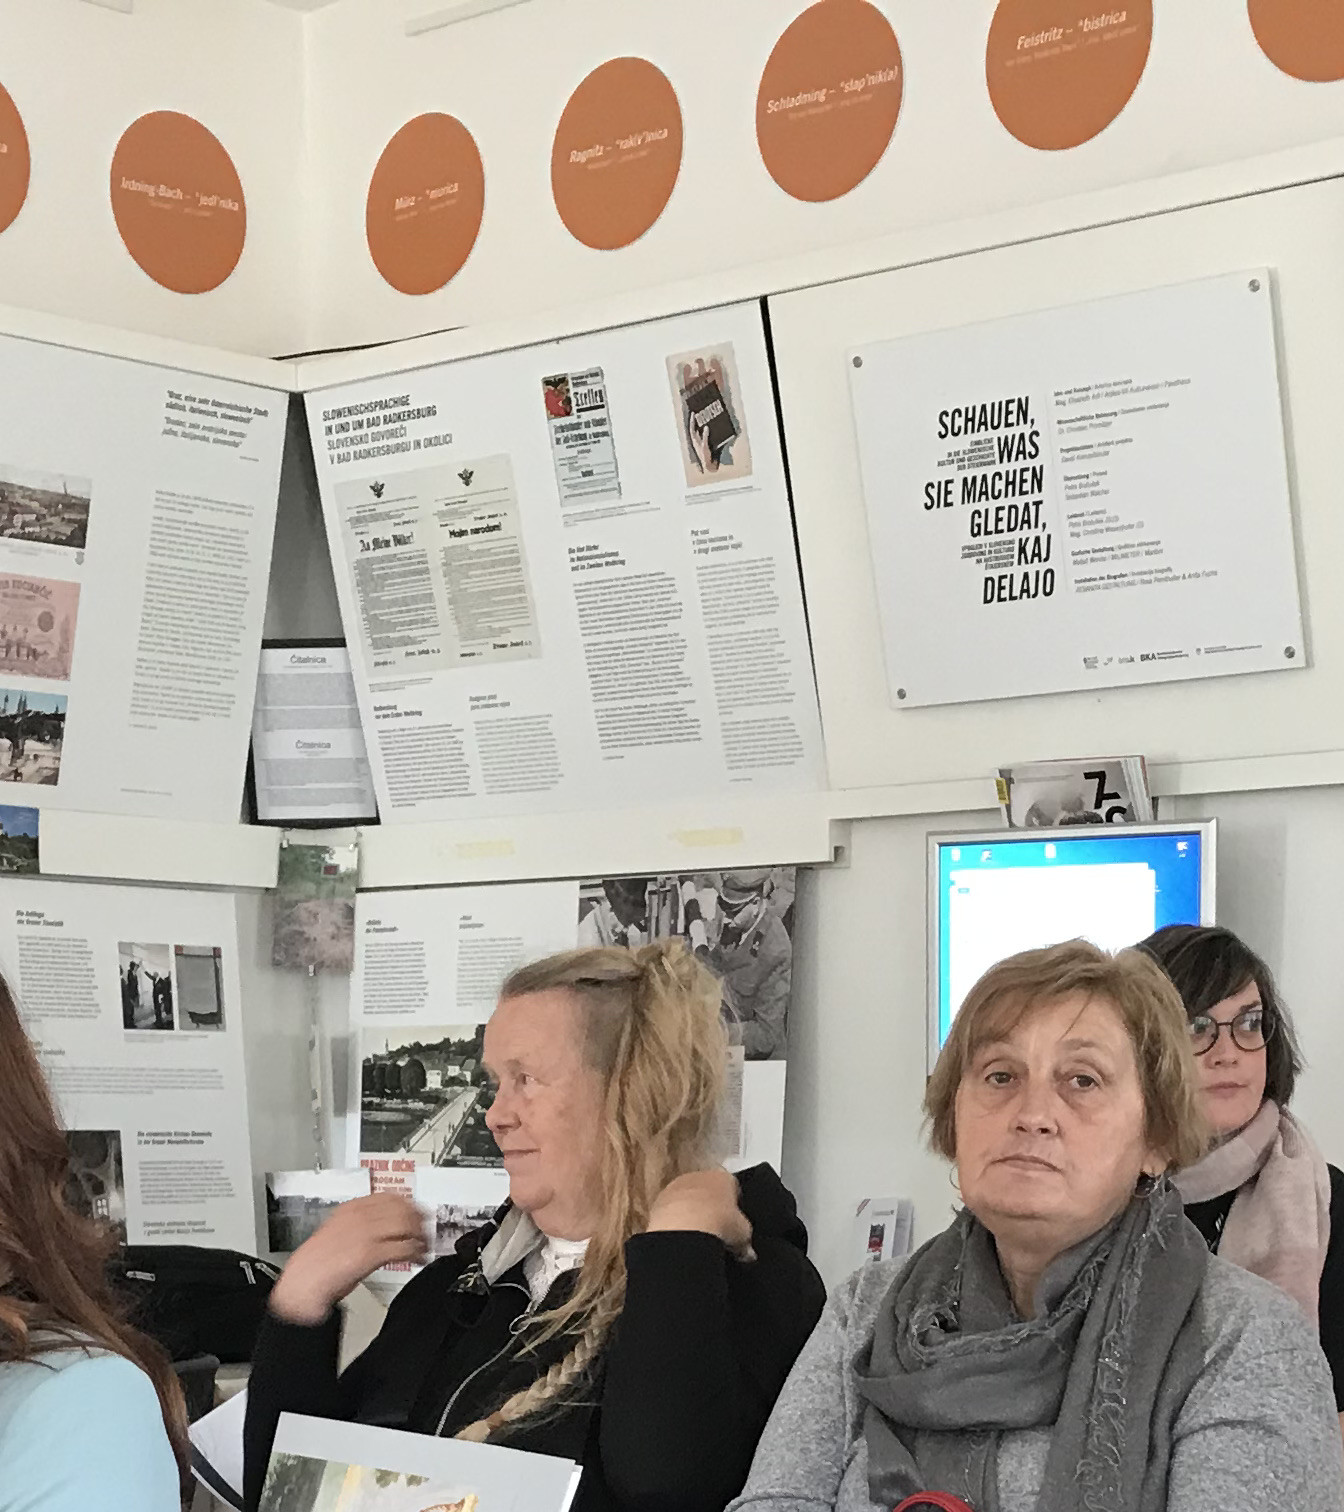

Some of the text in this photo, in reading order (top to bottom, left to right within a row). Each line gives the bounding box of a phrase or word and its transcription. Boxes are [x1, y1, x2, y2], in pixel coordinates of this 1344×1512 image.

[1017, 25, 1063, 50] Feistritz
[767, 87, 827, 115] Schladming
[323, 394, 410, 422] SLOWENISCHSPRACHIGE
[325, 405, 437, 436] IN UND UM BAD RADKERSBURG
[938, 396, 1035, 439] SCHAUEN,
[327, 424, 407, 450] SLOVENSKO GOVOREČI
[330, 433, 453, 464] V BAD RADKERSBURGU IN OKOLICI
[997, 430, 1040, 464] WAS
[923, 478, 955, 510] SIE
[961, 464, 1044, 505] MACHEN
[970, 500, 1047, 538] GLEDAT,
[1017, 534, 1052, 566] KAJ
[983, 568, 1055, 604] DELAJO
